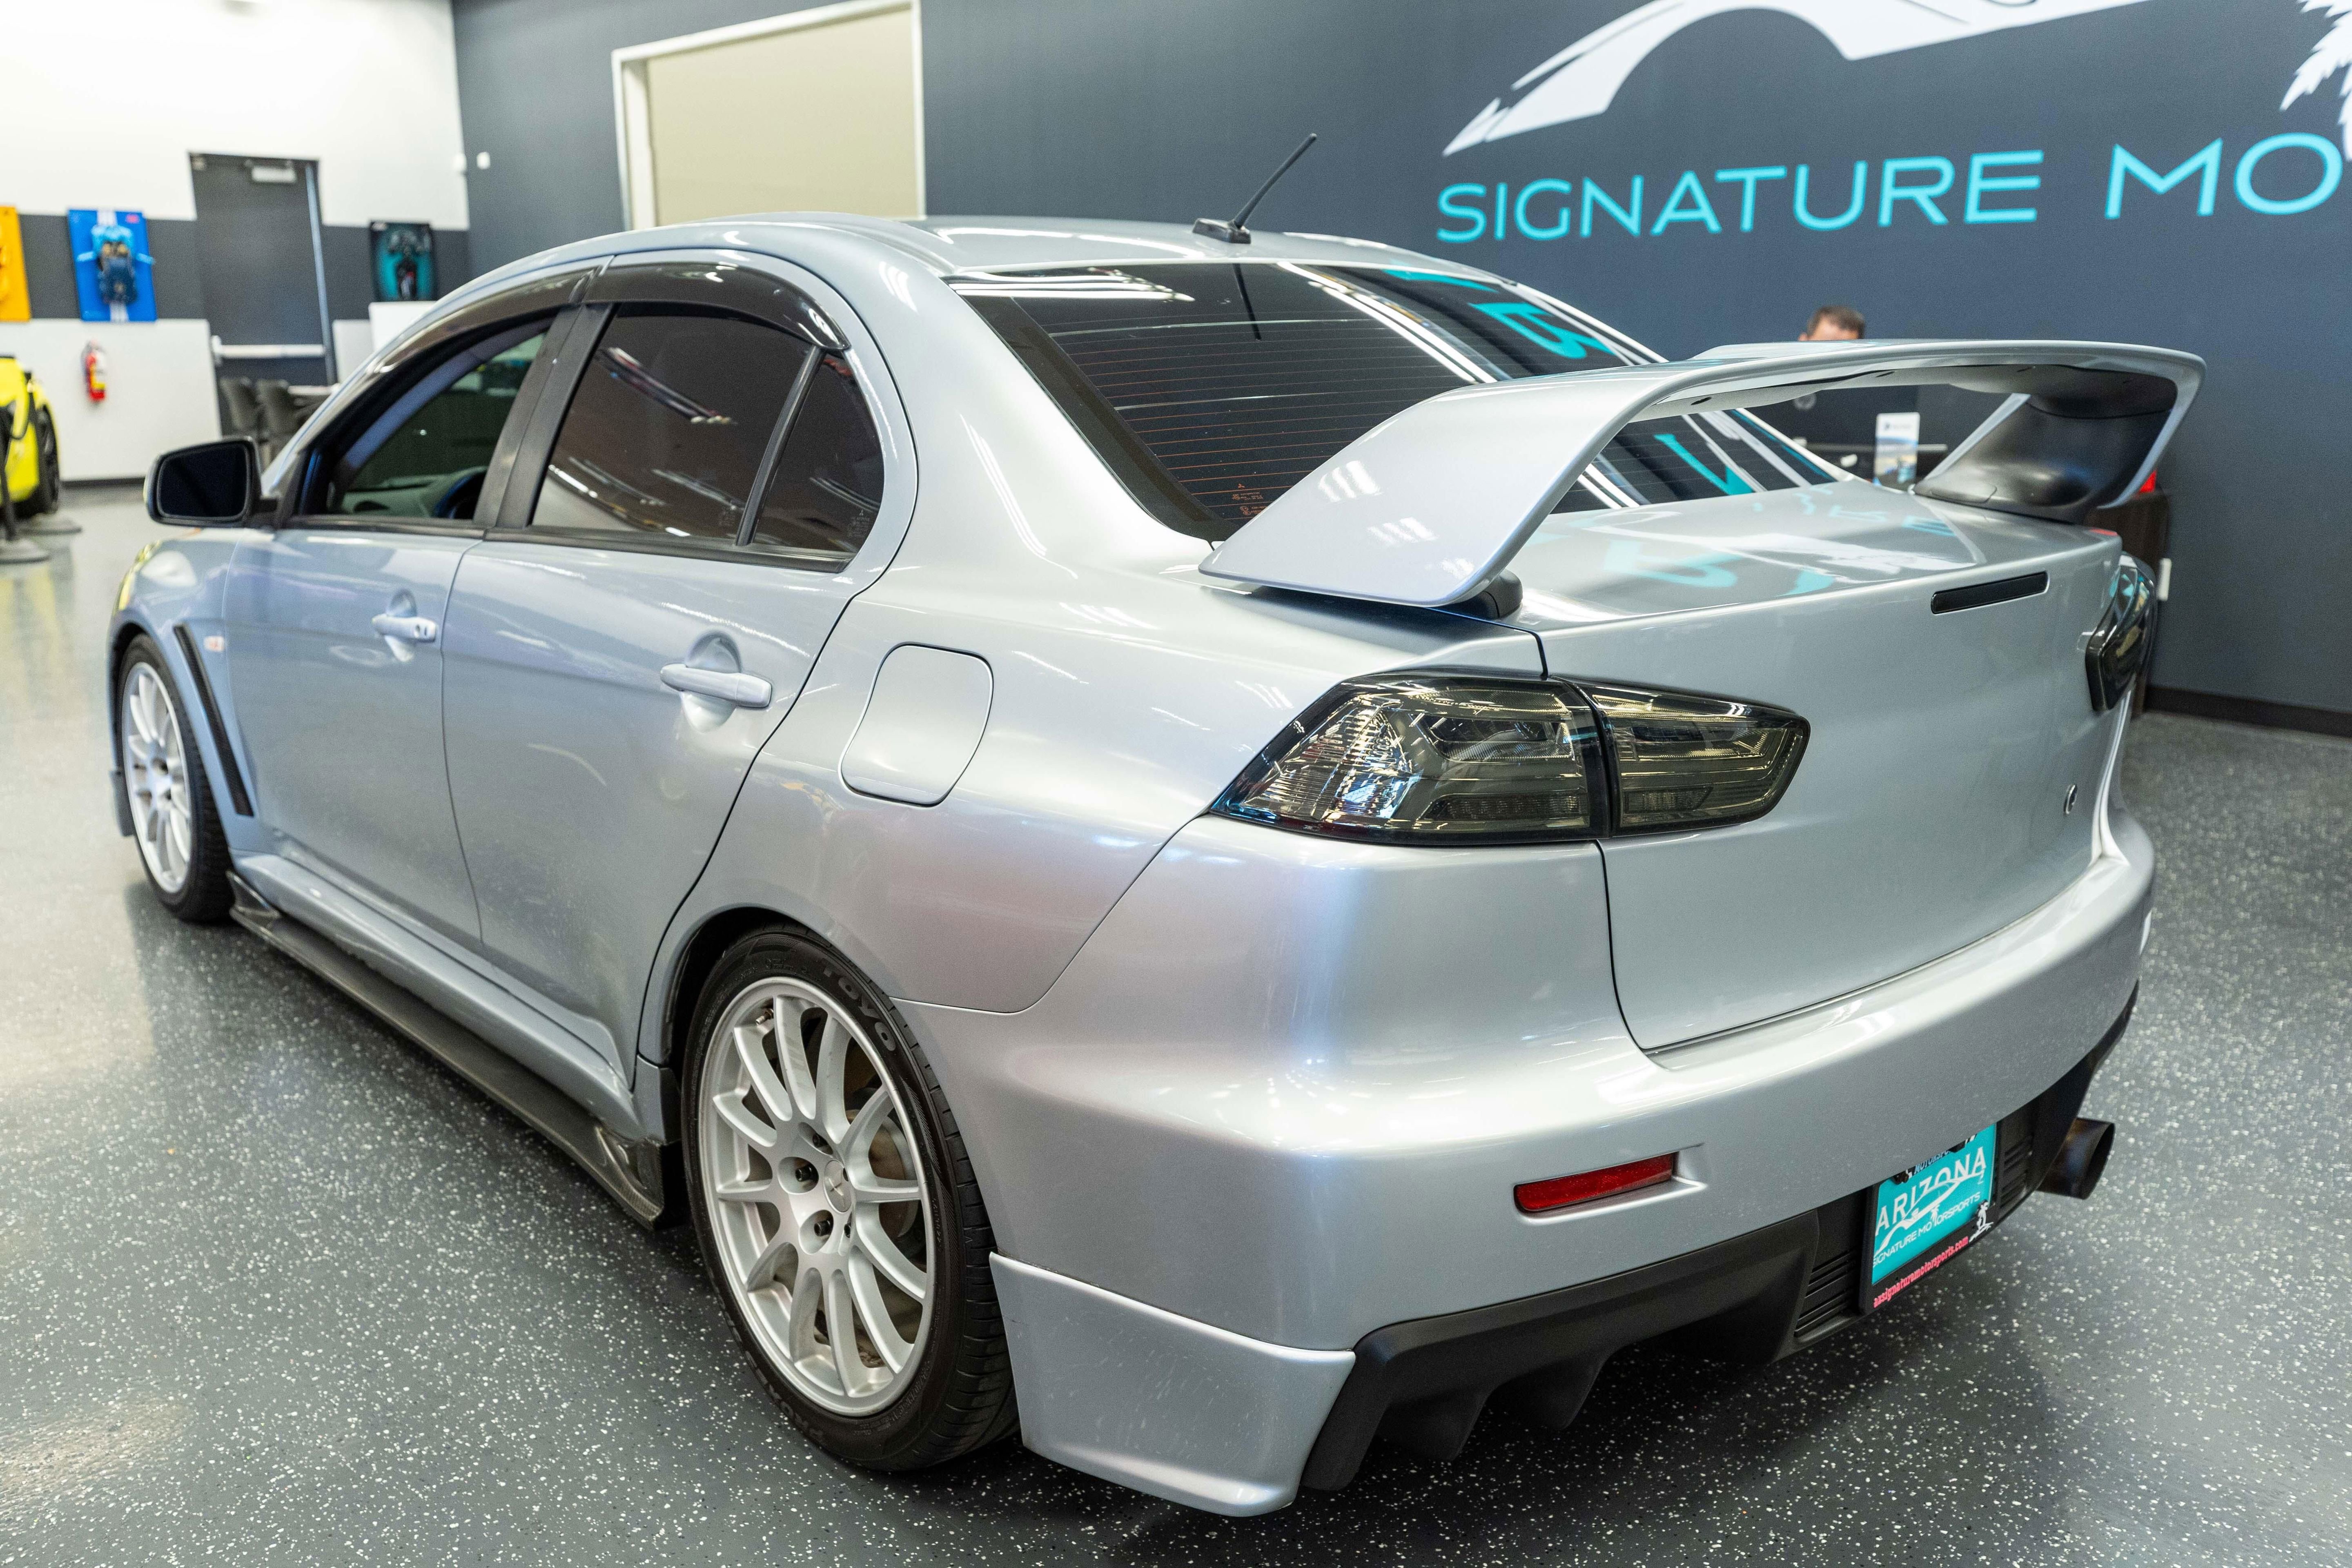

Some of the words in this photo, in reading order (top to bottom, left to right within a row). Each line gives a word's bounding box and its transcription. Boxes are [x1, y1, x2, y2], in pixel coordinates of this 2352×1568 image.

[1436, 149, 2045, 244] SIGNATURE
[820, 957, 896, 1051] TOYO
[1875, 1146, 1987, 1237] ARIZONA
[1873, 1230, 1918, 1267] SIGNATURE
[1873, 1236, 1969, 1308] azsignaturemotorsports.com
